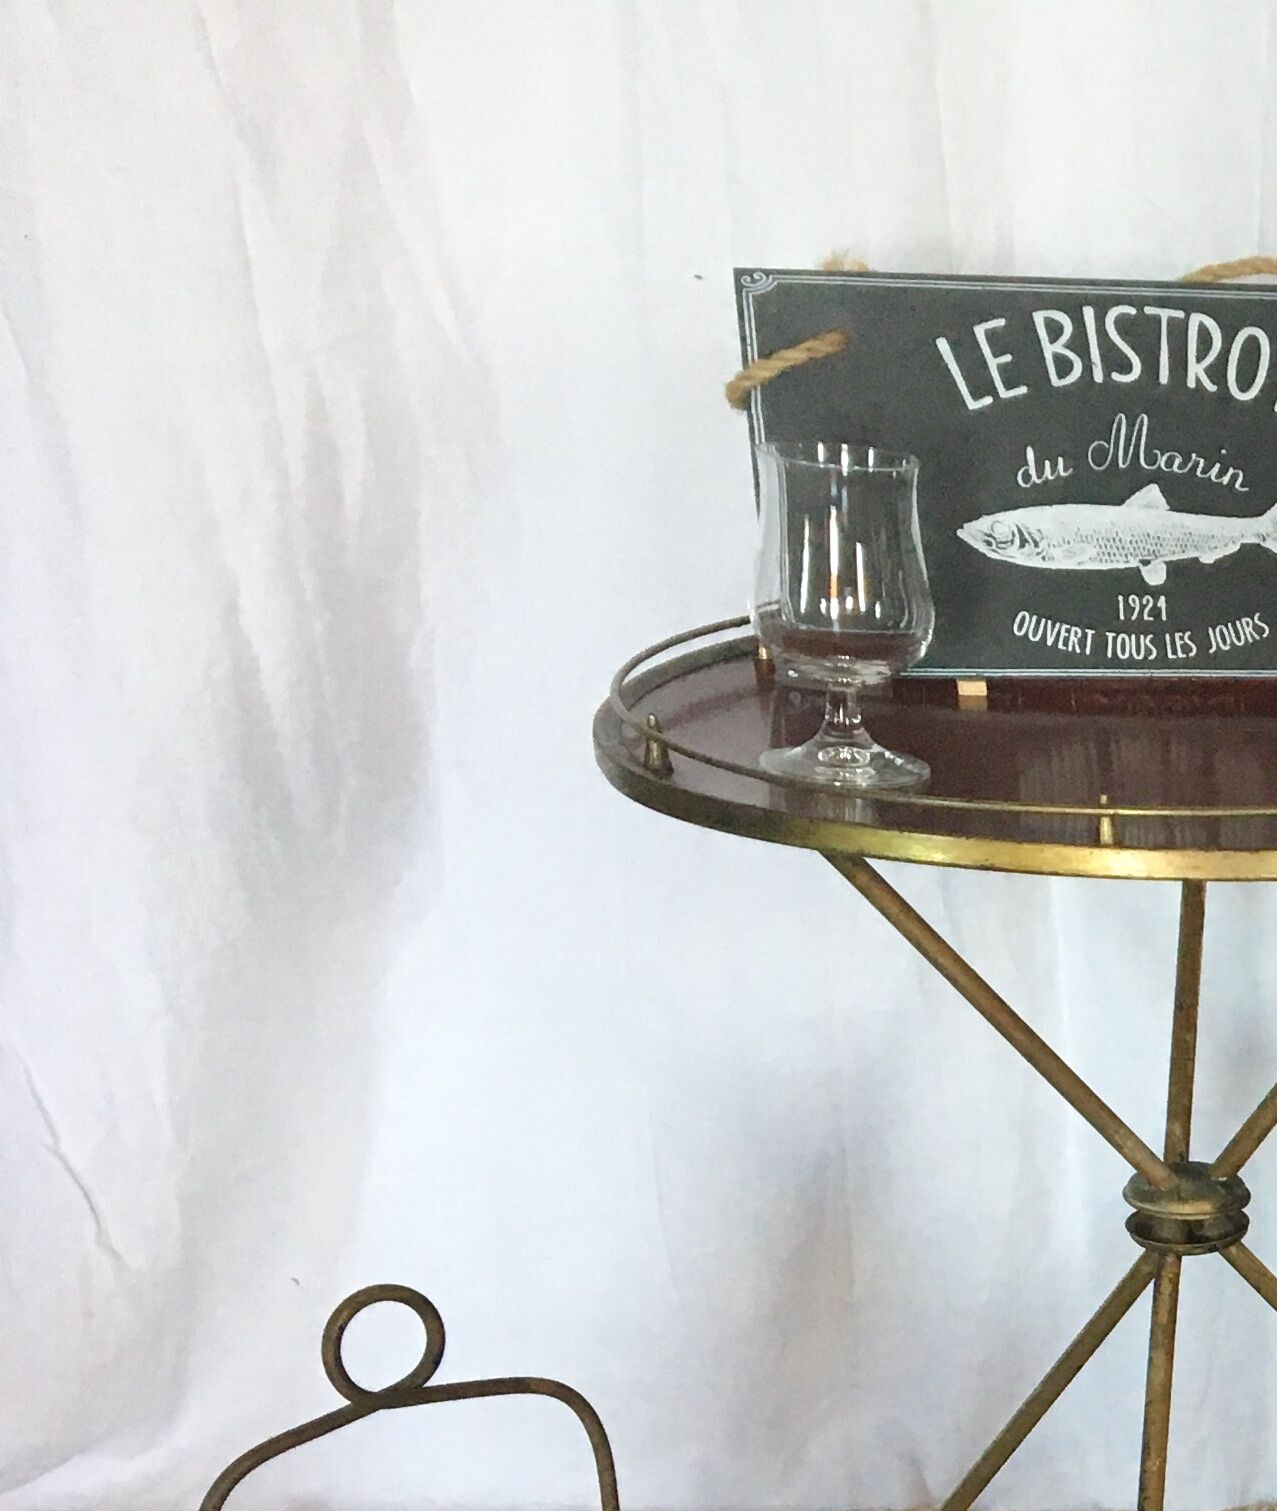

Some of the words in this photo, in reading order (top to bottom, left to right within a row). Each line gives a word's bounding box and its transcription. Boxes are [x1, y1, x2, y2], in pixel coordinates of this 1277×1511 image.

[935, 317, 1028, 411] LE
[1016, 445, 1073, 488] du
[1087, 412, 1249, 492] Marin
[1012, 610, 1096, 656] OUVERT
[1105, 631, 1158, 660] TOUS
[1165, 630, 1197, 660] LES
[1208, 612, 1270, 654] JOURS
